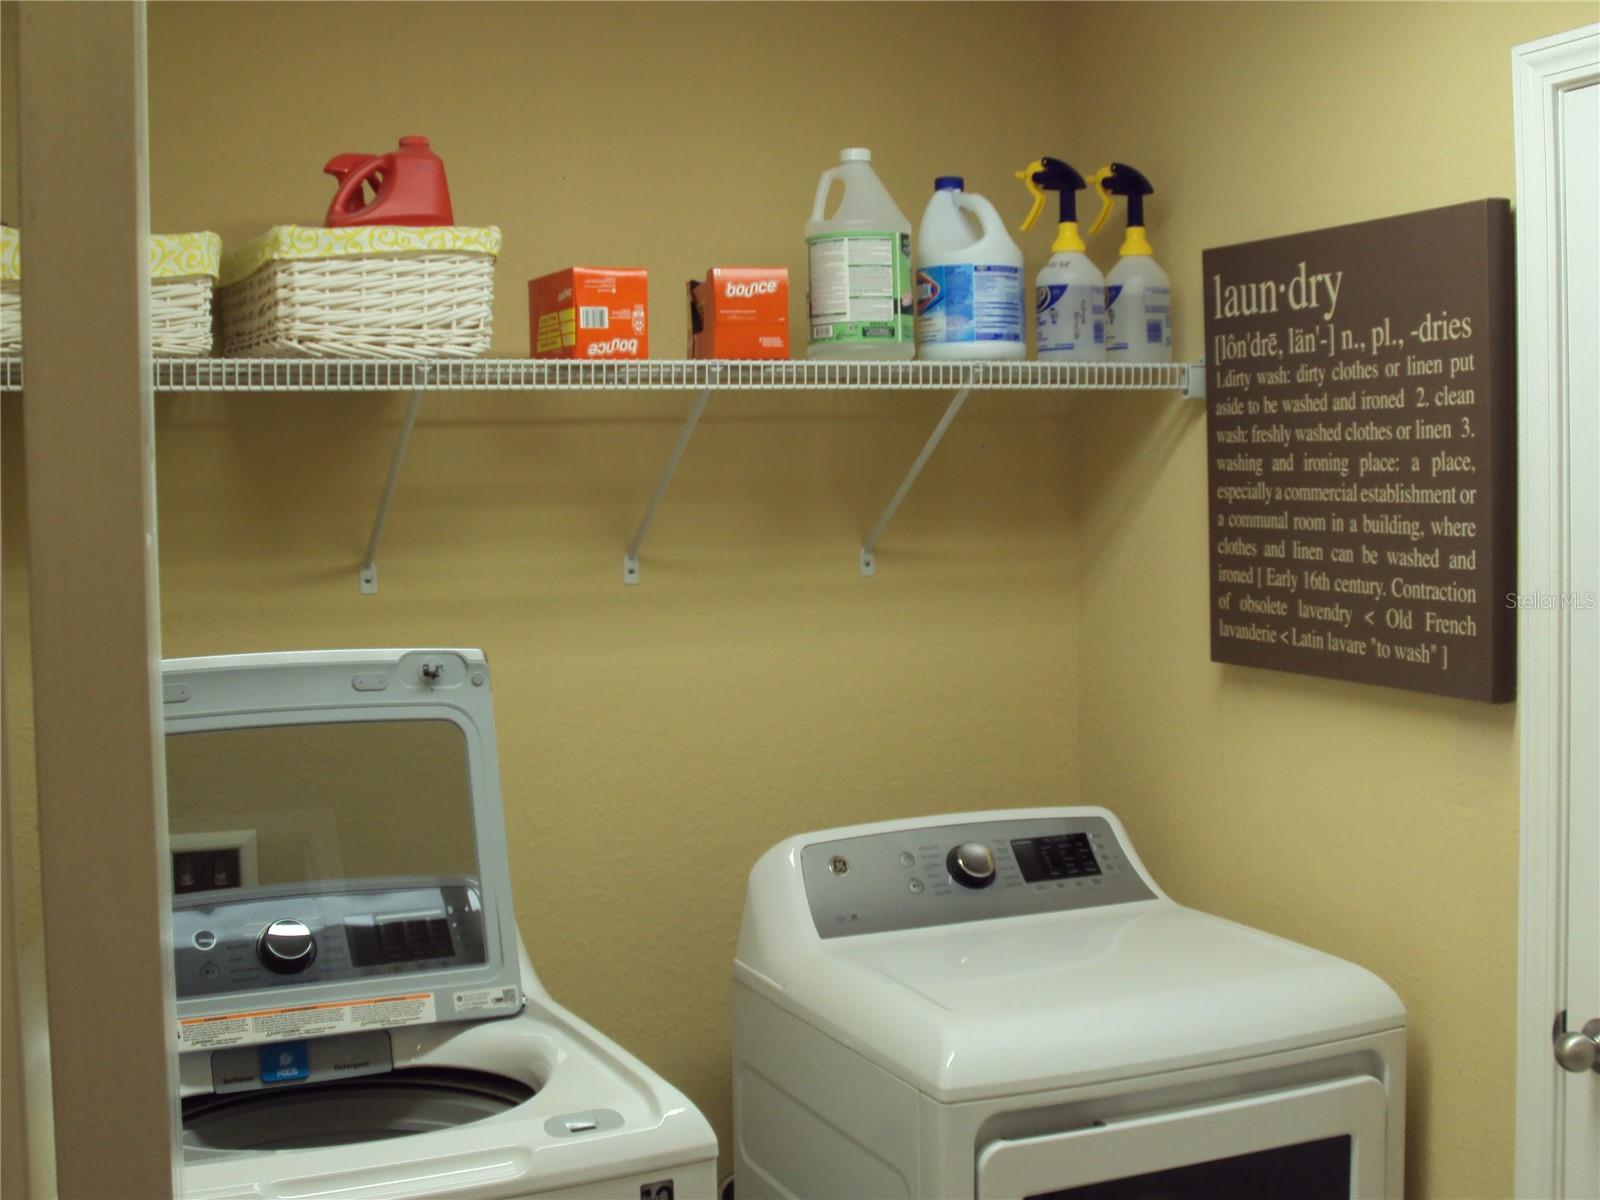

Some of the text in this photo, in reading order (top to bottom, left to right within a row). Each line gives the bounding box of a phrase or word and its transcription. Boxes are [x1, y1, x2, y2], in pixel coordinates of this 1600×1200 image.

[725, 280, 778, 297] bounce
[1411, 311, 1472, 343] -dries
[588, 338, 638, 355] bounce
[1258, 367, 1290, 384] wash:
[1297, 365, 1325, 387] dirty
[1332, 361, 1378, 380] clothes
[1386, 363, 1400, 376] or
[1407, 355, 1442, 375] linen
[1451, 354, 1474, 378] put
[1216, 386, 1475, 416] aside to be washed and ironed 2. clean
[1217, 417, 1474, 446] wash: freshly washed clothes or linen 3.
[1217, 451, 1475, 476] washing and ironing place: a place,
[1217, 482, 1476, 504] especially a commercial establishment or
[1218, 512, 1476, 540] a communal room in a building, where
[1218, 538, 1476, 570] clothes and linen can be washed and
[1219, 565, 1254, 584] ironed
[1267, 569, 1298, 592] Early
[1304, 571, 1329, 591] 16th
[1335, 578, 1386, 603] century.
[1391, 578, 1476, 603] Contraction
[1219, 593, 1232, 609] of
[1240, 595, 1287, 615] obsolete
[1299, 600, 1351, 629] lavendry
[1387, 609, 1412, 629] Old
[1426, 612, 1477, 636] French
[1219, 620, 1277, 643] lavanderie
[1292, 628, 1323, 649] Latin
[1328, 633, 1367, 655] lavare
